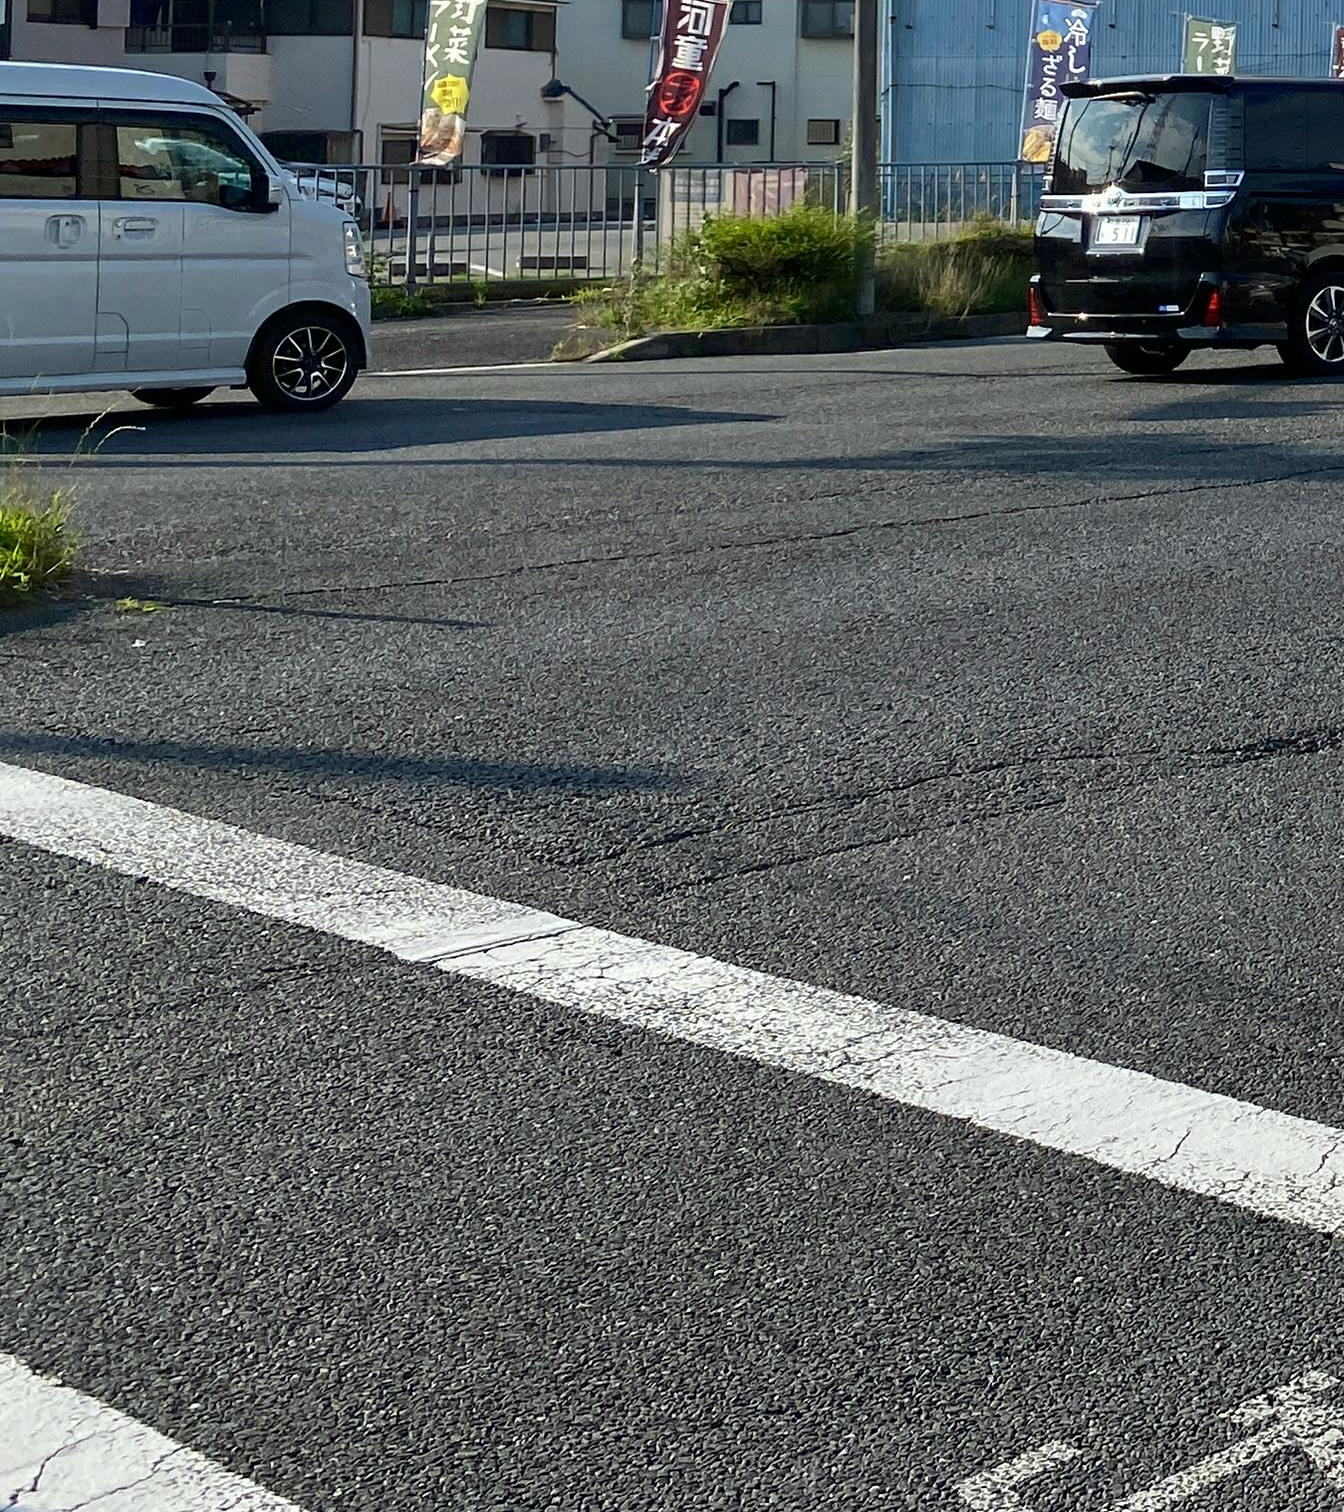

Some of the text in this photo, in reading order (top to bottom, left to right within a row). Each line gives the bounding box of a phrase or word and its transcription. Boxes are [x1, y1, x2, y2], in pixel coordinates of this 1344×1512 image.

[1064, 18, 1089, 74] 冷し
[1034, 55, 1063, 121] ざる麺
